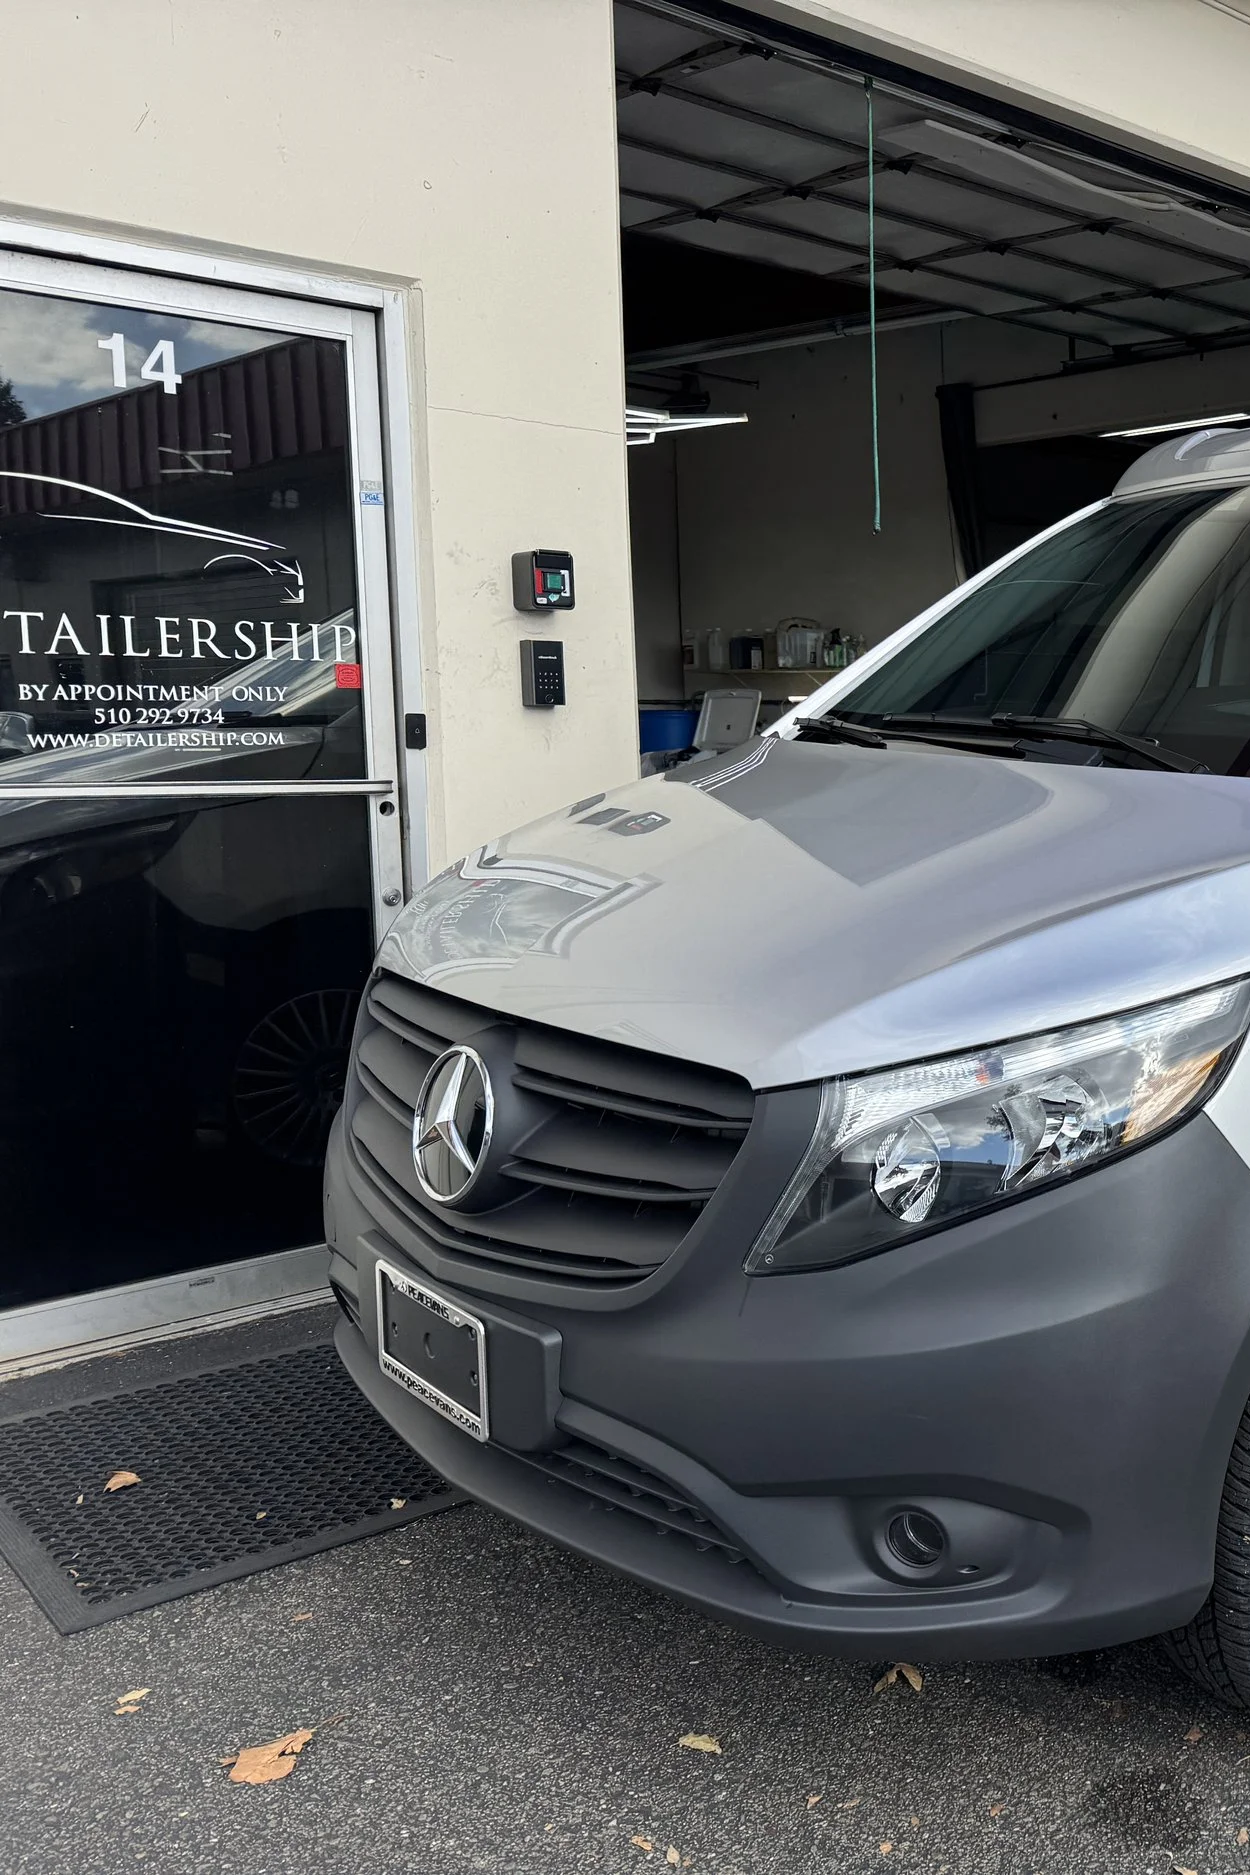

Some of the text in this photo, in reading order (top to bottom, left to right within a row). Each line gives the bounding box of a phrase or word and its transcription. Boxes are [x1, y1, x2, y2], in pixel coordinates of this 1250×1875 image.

[97, 333, 182, 395] 14
[18, 684, 288, 702] BY APPOINTMENT ONLY
[94, 707, 225, 725] 510 292 9734
[26, 732, 285, 749] WWW.DETAILERSHIP.COM
[382, 1358, 481, 1436] www.peacevans.com
